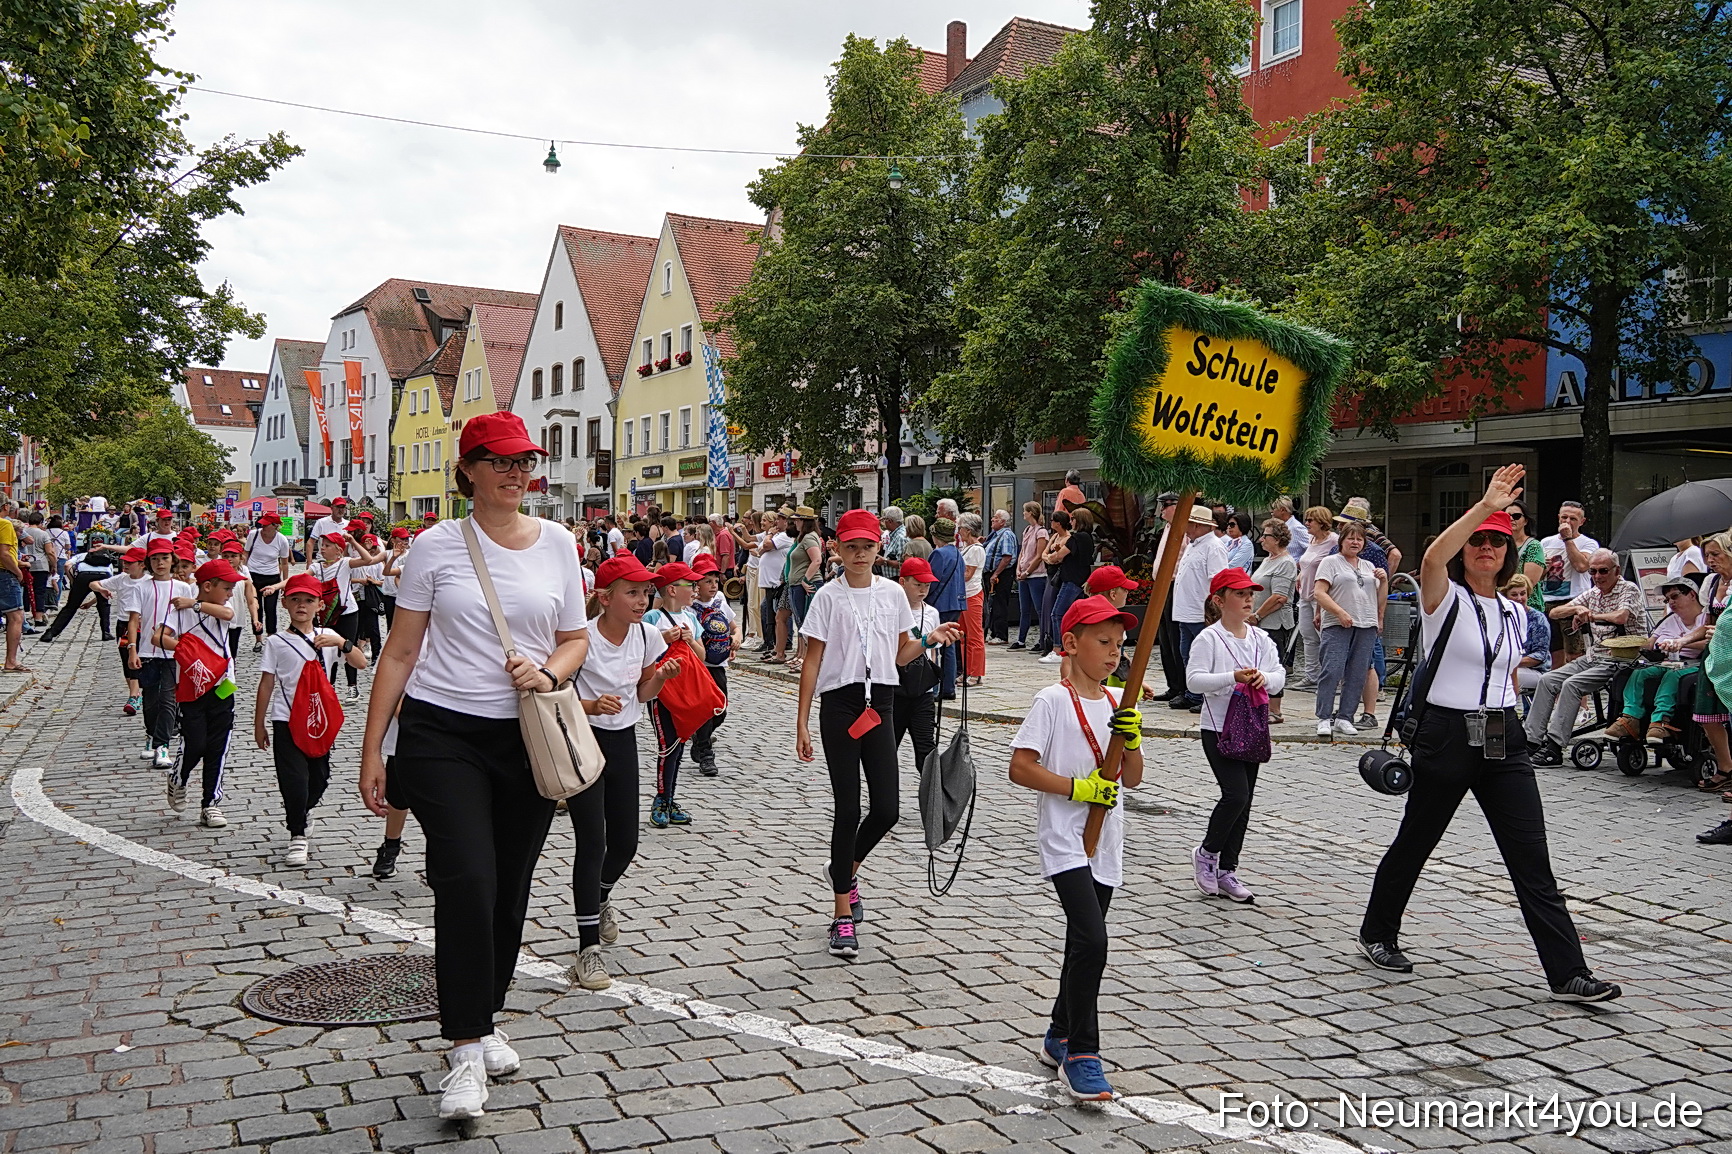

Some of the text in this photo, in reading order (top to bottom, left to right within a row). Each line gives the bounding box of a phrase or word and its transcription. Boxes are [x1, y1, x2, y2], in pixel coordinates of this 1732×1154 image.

[1186, 335, 1279, 394] Schule
[348, 389, 363, 431] SALE
[1152, 391, 1279, 454] Wolfstein
[415, 426, 430, 439] HOTEL
[1644, 554, 1668, 565] BABOR
